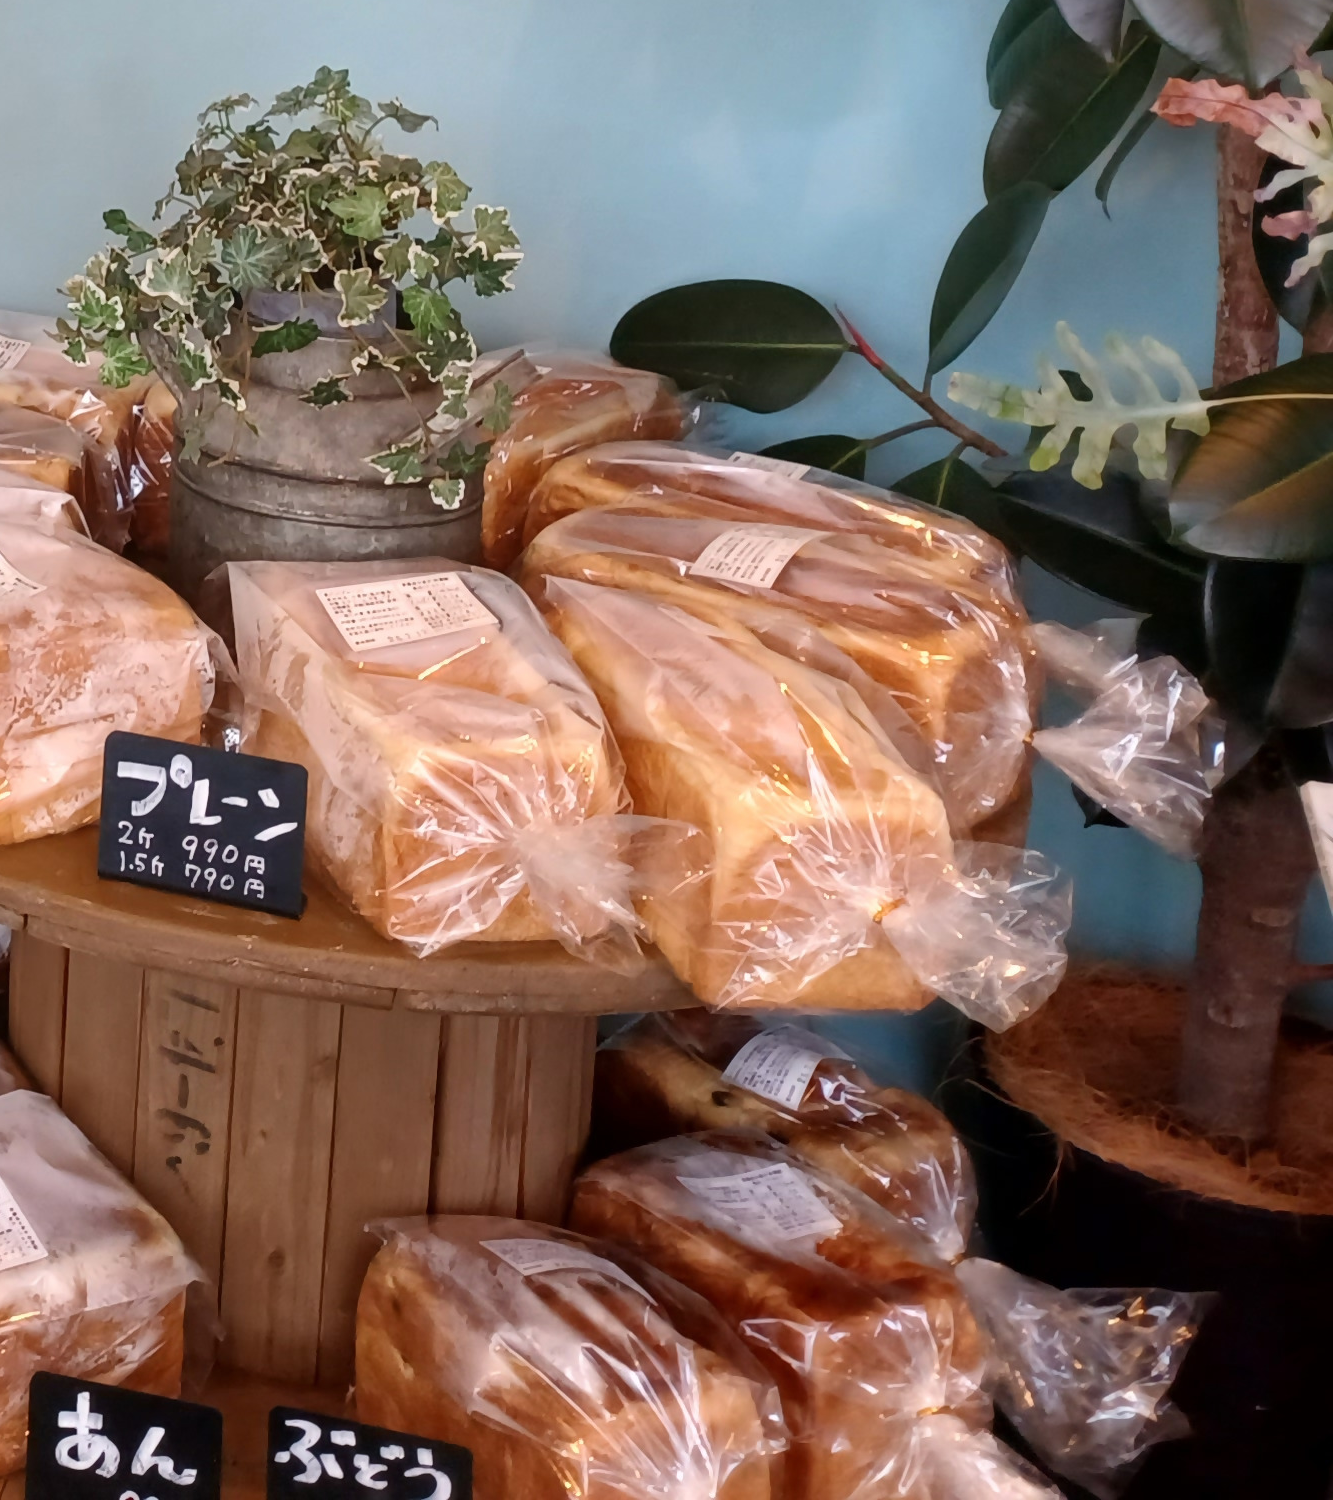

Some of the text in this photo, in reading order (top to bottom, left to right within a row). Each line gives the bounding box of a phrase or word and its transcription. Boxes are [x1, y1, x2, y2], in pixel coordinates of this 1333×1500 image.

[116, 753, 299, 842] プレーン
[117, 820, 266, 875] 2斤 990円
[119, 850, 265, 900] 1.5斤 790円
[53, 1390, 199, 1487] あん
[273, 1418, 453, 1500] ぶどう
